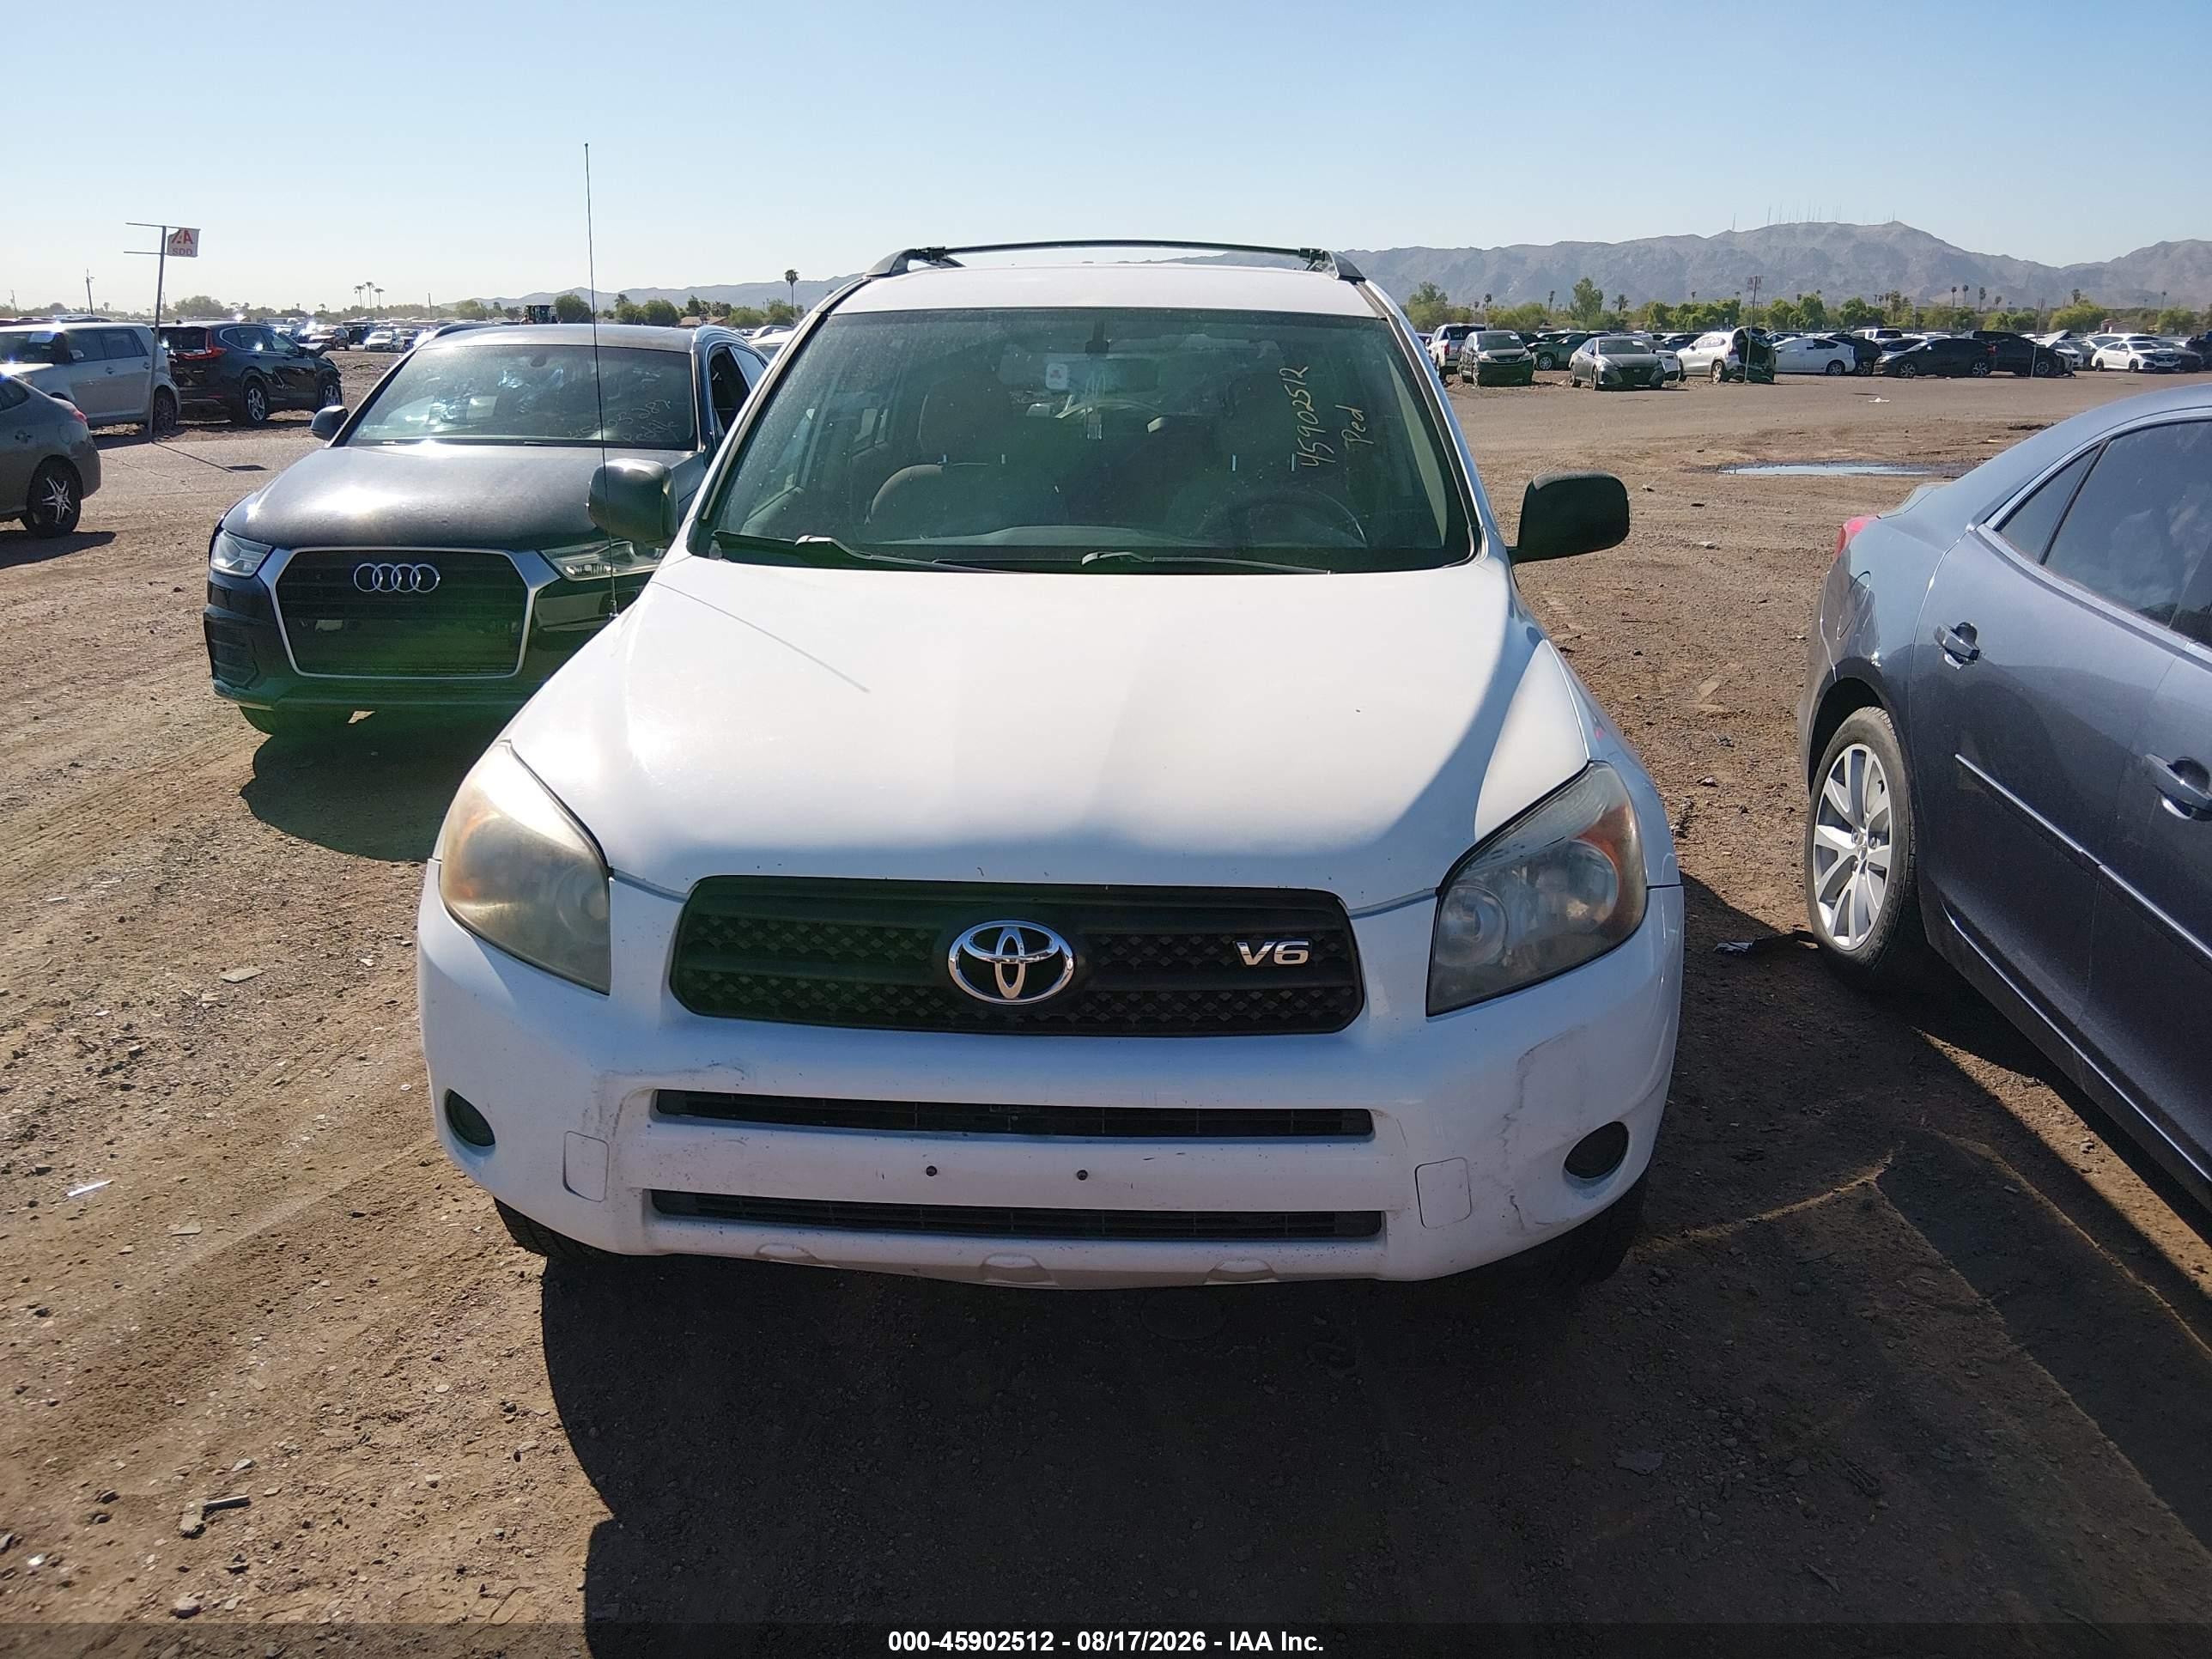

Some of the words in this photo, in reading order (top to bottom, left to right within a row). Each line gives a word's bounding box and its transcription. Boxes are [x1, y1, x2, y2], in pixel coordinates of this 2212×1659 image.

[1279, 366, 1336, 467] 45902512
[1334, 404, 1374, 445] Ped
[1236, 940, 1310, 967] V6
